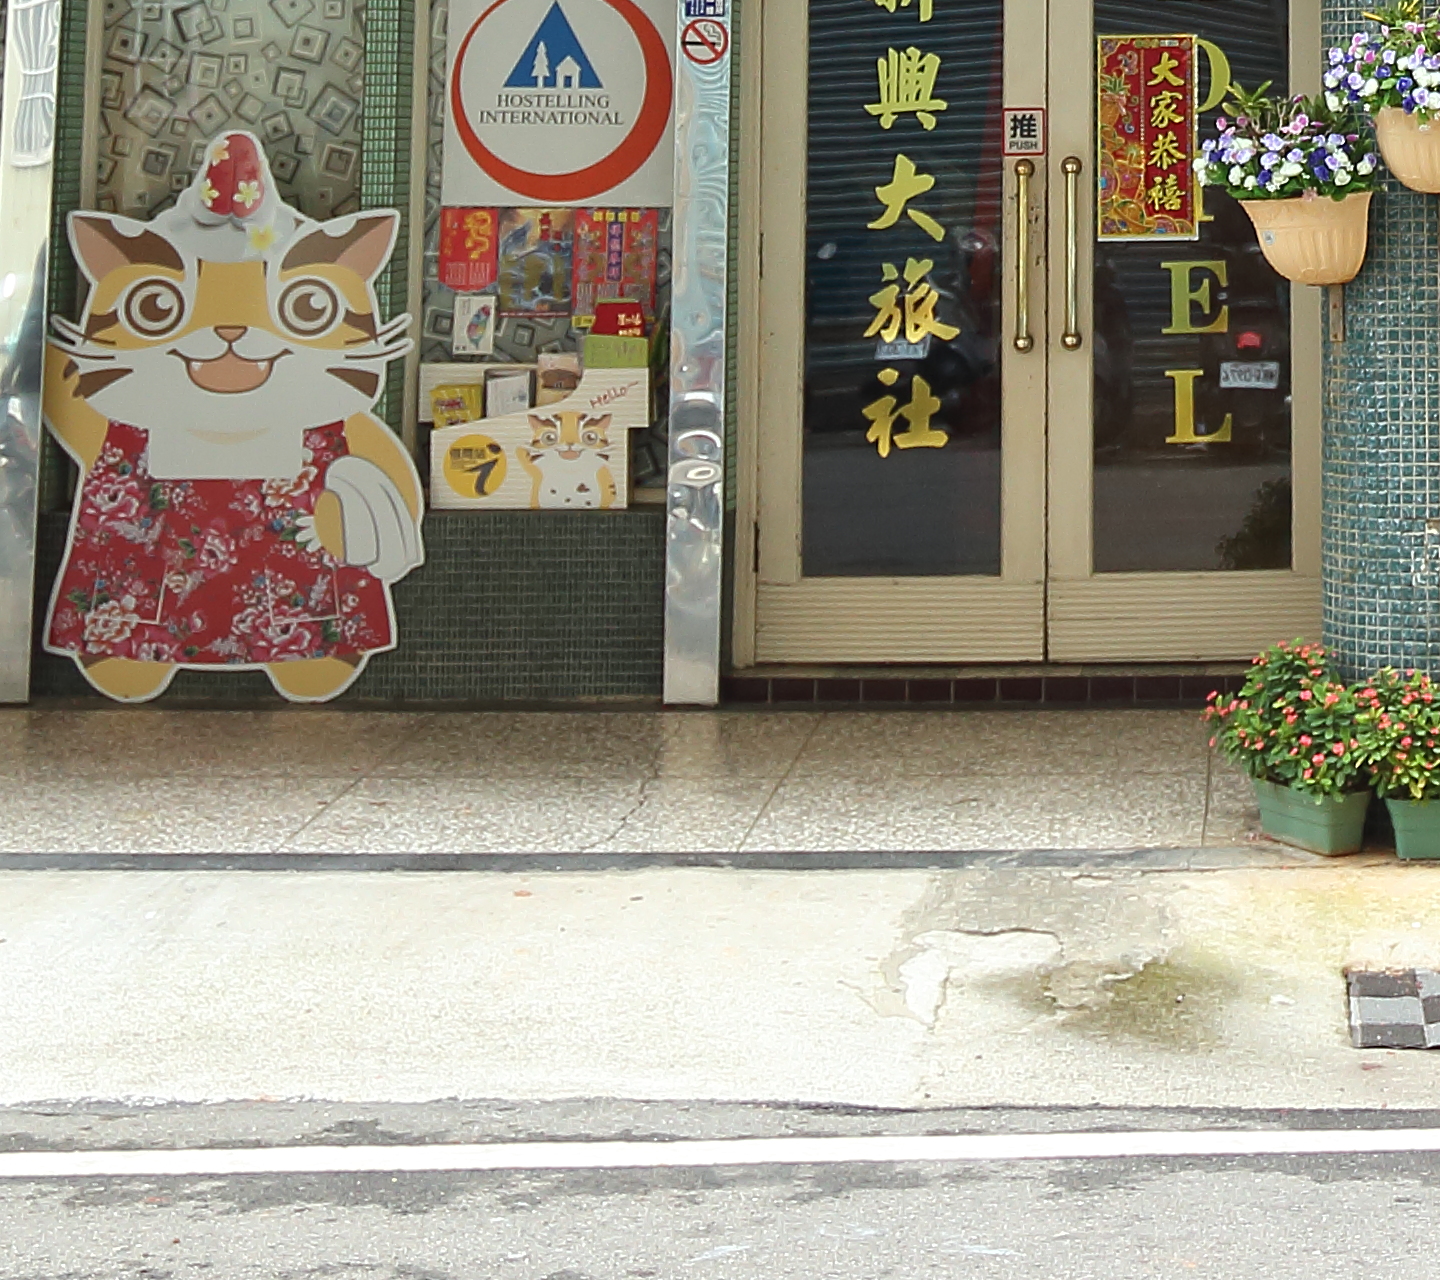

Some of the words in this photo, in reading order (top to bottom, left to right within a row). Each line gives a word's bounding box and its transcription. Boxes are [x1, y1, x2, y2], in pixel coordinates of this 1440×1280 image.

[497, 94, 609, 109] HOSTELLING
[479, 110, 624, 125] INTERNATIONAL
[1010, 114, 1037, 138] 推
[1147, 52, 1186, 212] 大家恭禧
[1009, 141, 1038, 150] PUSH
